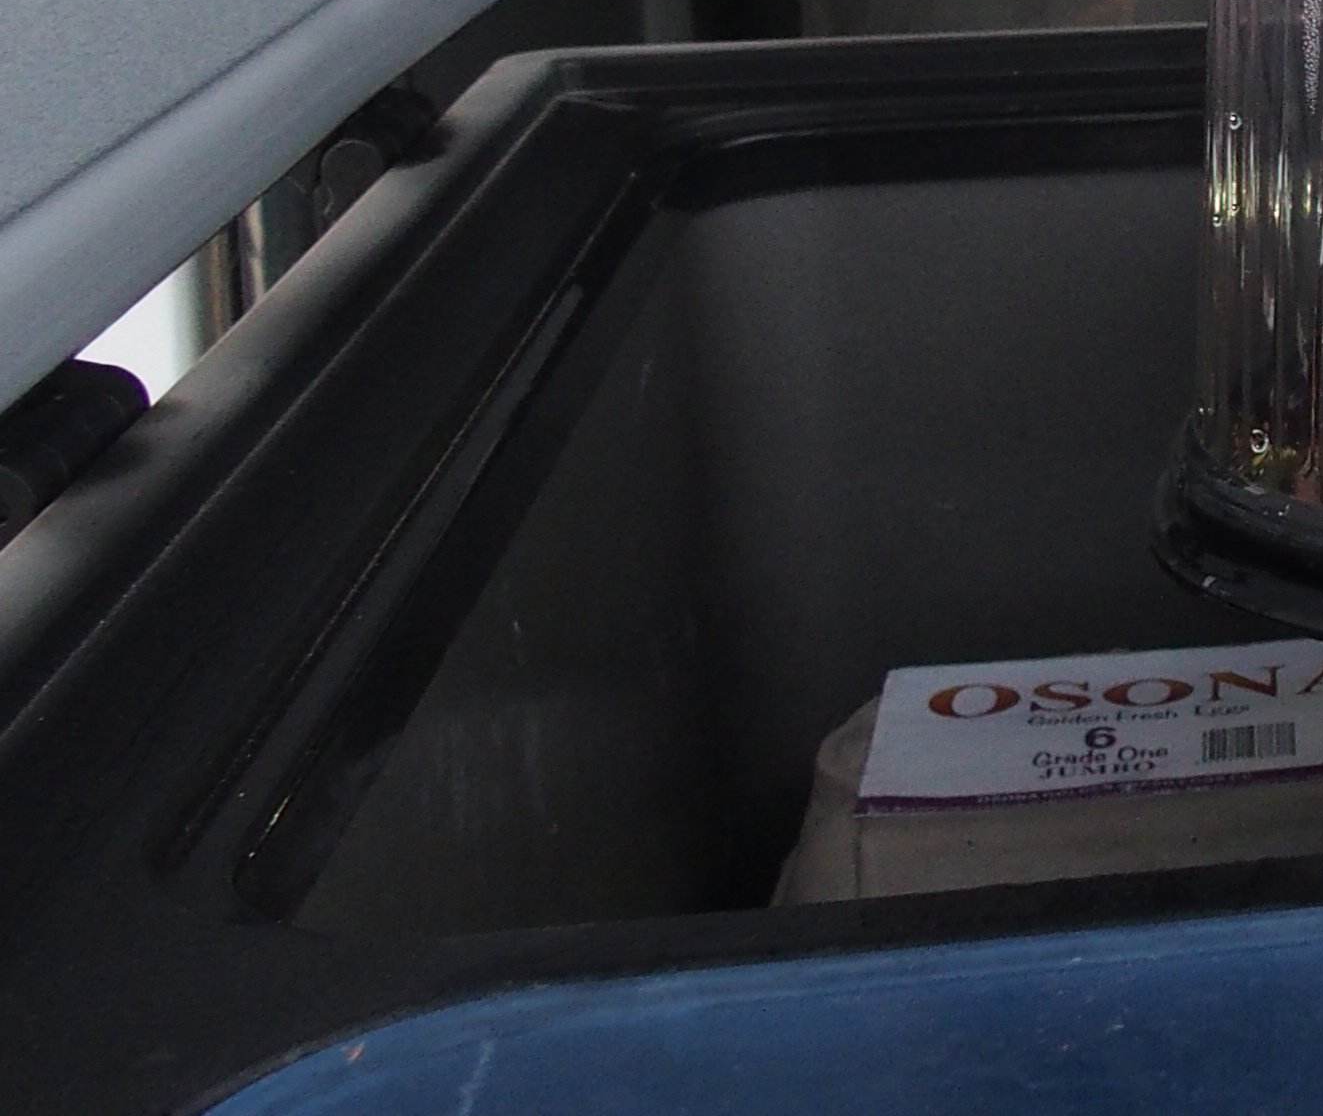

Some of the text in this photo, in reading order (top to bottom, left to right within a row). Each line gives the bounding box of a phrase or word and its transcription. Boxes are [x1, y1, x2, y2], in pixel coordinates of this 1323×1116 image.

[1027, 712, 1108, 727] Golden
[1116, 709, 1179, 722] Fresh
[1084, 726, 1117, 749] 6
[1032, 746, 1169, 768] Grade One
[1039, 760, 1157, 781] JUMBO
